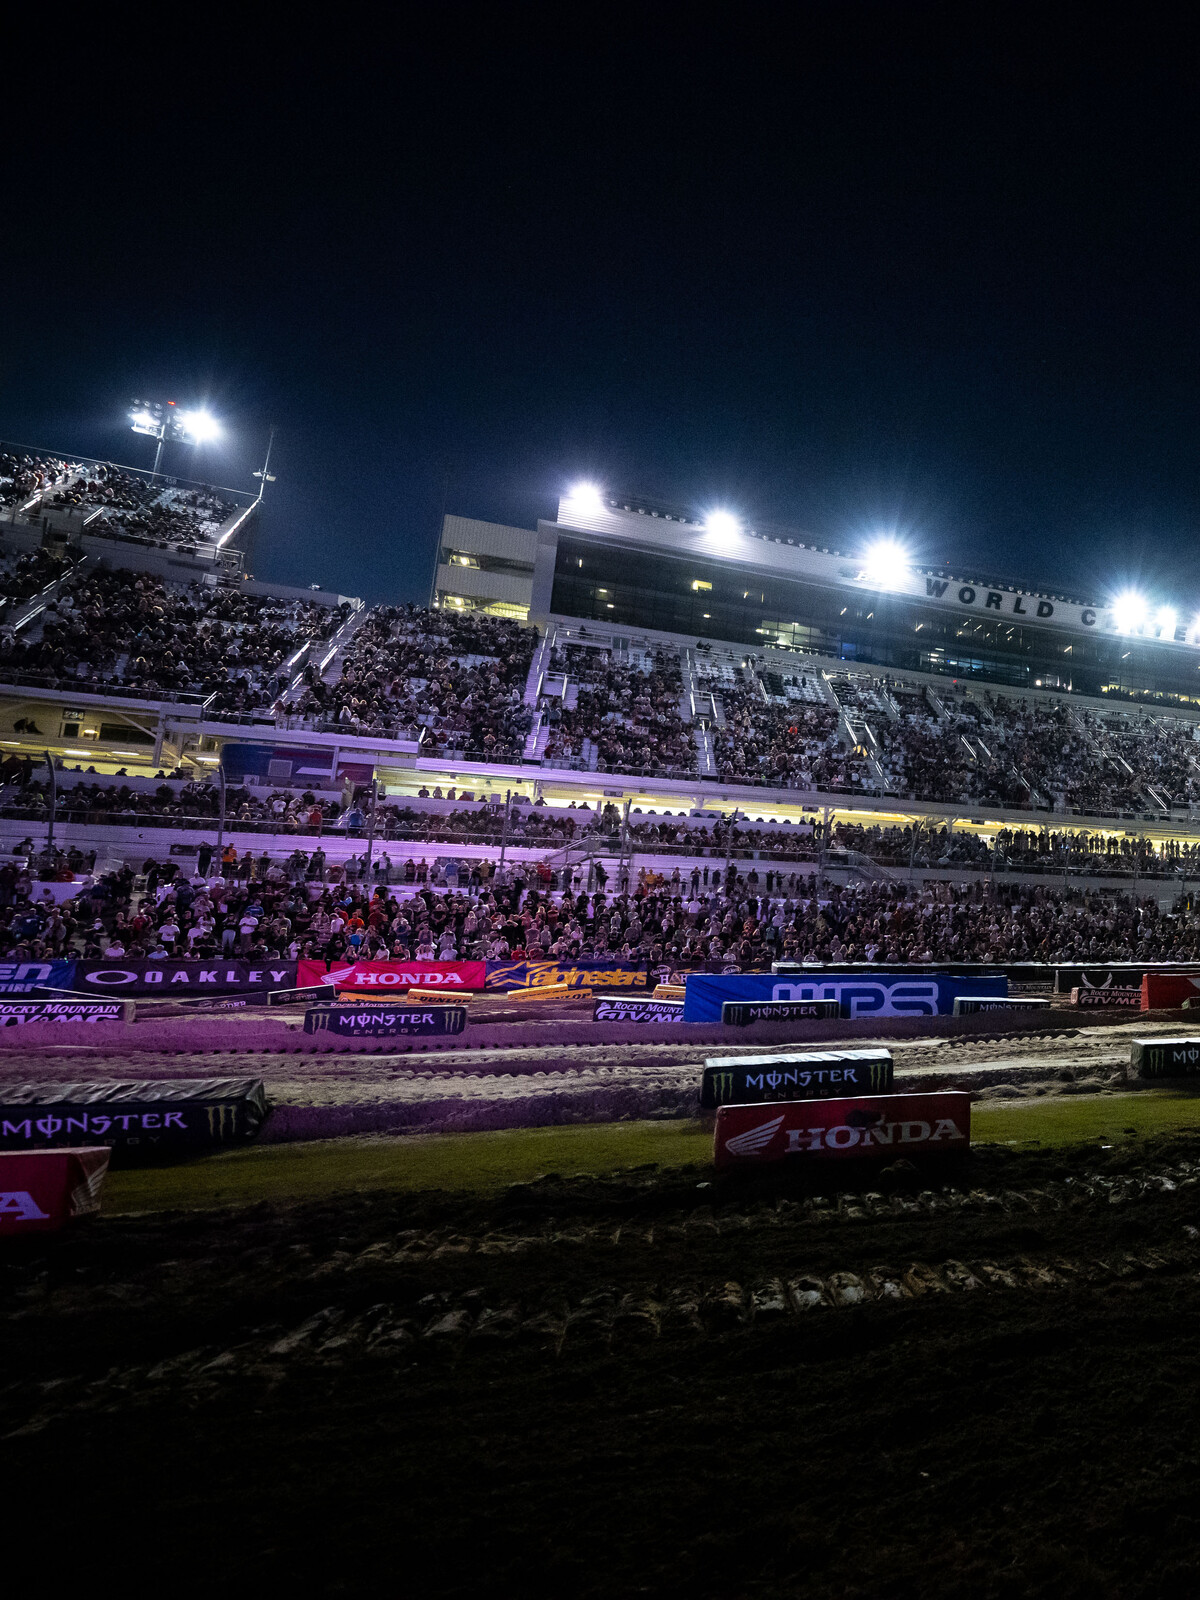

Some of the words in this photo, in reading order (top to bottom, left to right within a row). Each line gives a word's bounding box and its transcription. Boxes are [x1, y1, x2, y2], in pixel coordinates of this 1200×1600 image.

[926, 578, 1054, 618] WORLD
[144, 970, 289, 983] OAKLEY
[354, 972, 464, 985] HONDA
[531, 967, 648, 986] alpinestars
[1090, 989, 1109, 997] ROCKY
[41, 1002, 121, 1014] MOUNTAIN
[613, 1002, 645, 1011] ROCKY
[750, 1005, 818, 1019] MONSTER
[979, 1003, 1033, 1012] MONSTER
[339, 1012, 435, 1028] MONSTER
[353, 1027, 421, 1036] ENERGY
[745, 1068, 859, 1090] MONSTER
[764, 1088, 842, 1100] ENERGY
[1, 1111, 188, 1139] MONSTER
[785, 1118, 966, 1153] HONDA
[34, 1135, 161, 1150] ENERGY
